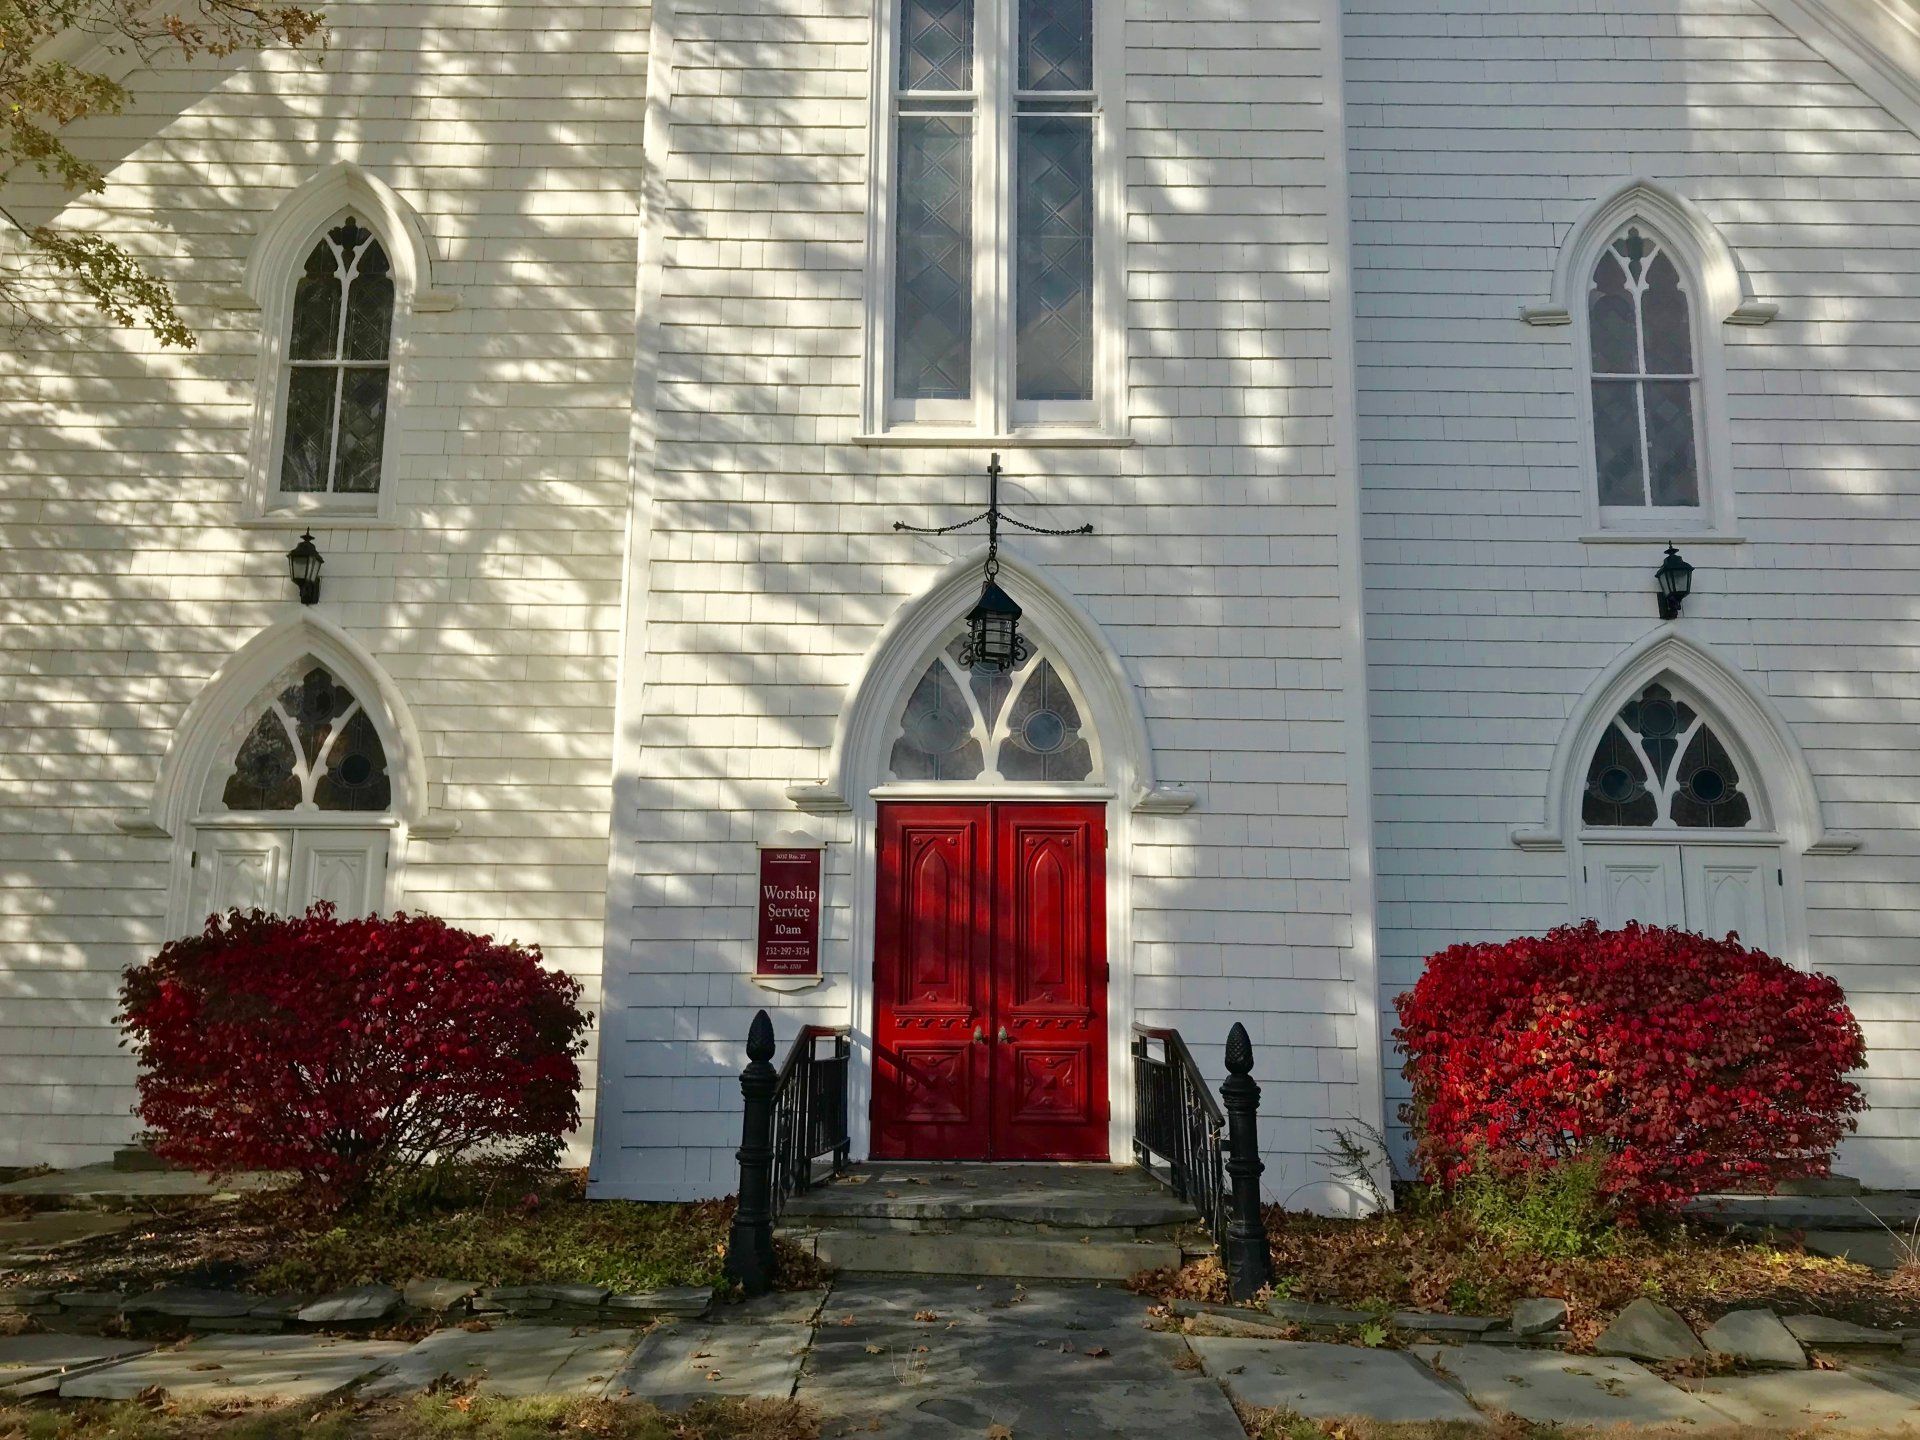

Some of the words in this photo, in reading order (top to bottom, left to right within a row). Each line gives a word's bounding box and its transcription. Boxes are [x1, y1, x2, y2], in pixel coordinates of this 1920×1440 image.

[763, 885, 816, 902] Worship
[768, 903, 810, 917] Service
[775, 924, 801, 935] 10am
[765, 946, 810, 956] 732-297-3734
